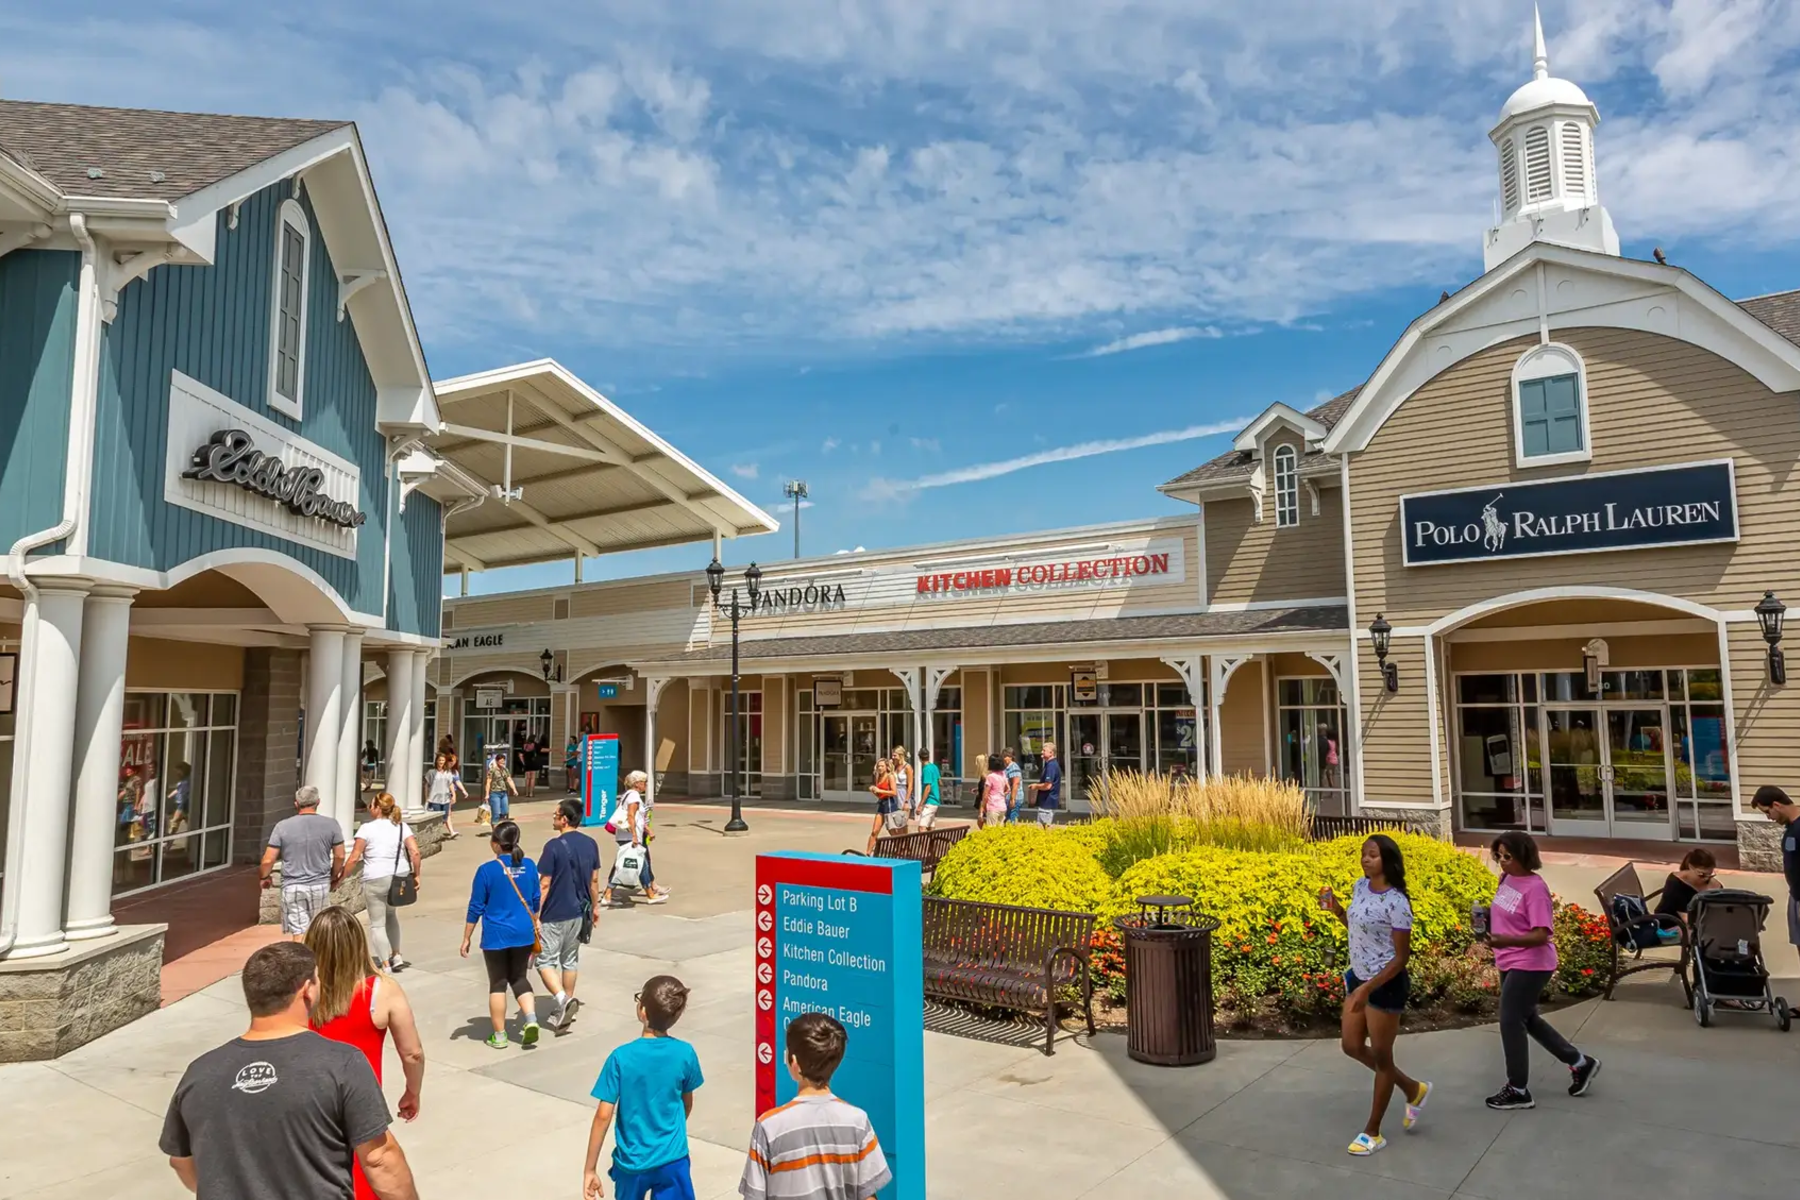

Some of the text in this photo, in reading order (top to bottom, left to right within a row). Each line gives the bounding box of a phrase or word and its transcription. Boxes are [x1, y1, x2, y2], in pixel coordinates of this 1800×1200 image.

[181, 429, 367, 528] Eddie Bauer
[917, 553, 1169, 593] KITCHEN COLLECTION
[473, 634, 504, 647] EAGLE
[485, 698, 493, 706] AE
[121, 742, 153, 767] ALE
[600, 789, 608, 819] Tanger
[783, 890, 857, 912] Parking Lot B
[783, 916, 850, 939] Eddie Bauer
[783, 943, 886, 972] Kitchen Collection
[783, 970, 828, 991] Pandora
[783, 996, 871, 1028] American Eagle
[242, 1067, 272, 1077] LOVE
